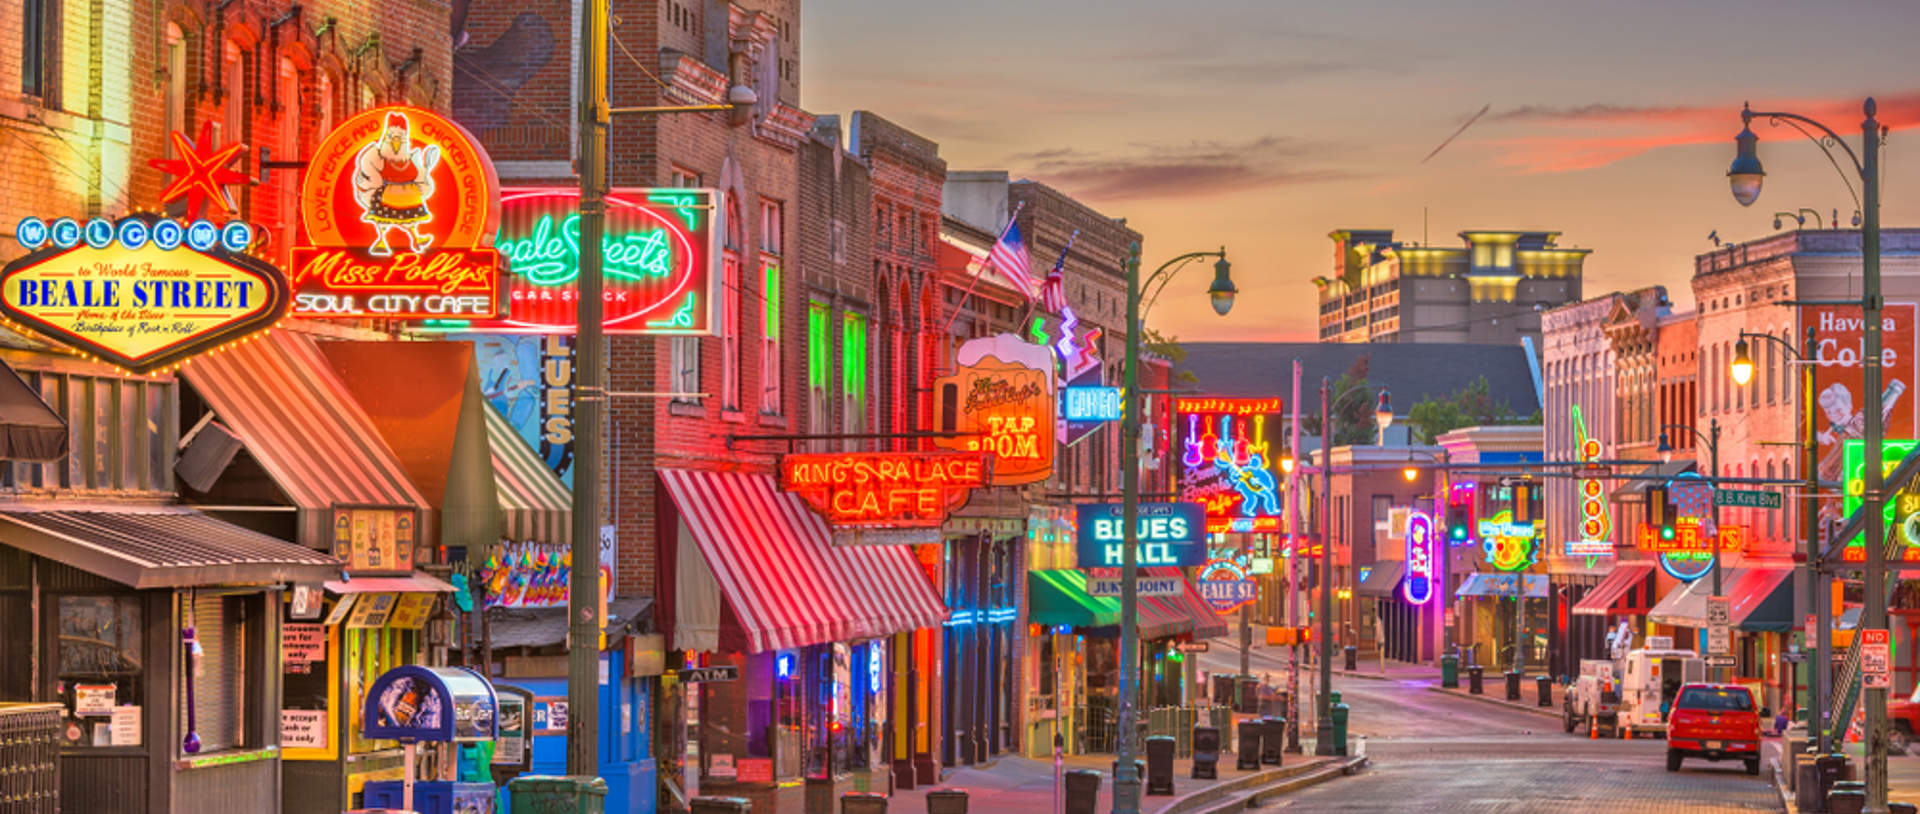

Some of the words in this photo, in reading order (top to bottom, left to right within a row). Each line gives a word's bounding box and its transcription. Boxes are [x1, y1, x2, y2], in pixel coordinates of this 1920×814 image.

[421, 122, 469, 172] CHICKEN
[22, 221, 250, 248] WELCOME
[500, 215, 567, 262] eale
[562, 215, 671, 281] Seets
[94, 262, 137, 277] World
[141, 262, 191, 277] Famous
[296, 251, 382, 283] Miss
[18, 279, 120, 307] BEALE
[132, 280, 253, 308] STREET
[296, 295, 363, 314] SOUL
[368, 295, 420, 313] CITY
[424, 295, 490, 314] CAFE
[512, 289, 553, 301] GAR
[561, 289, 628, 302] SCK
[1819, 311, 1864, 331] Hav
[1882, 317, 1895, 331] a
[546, 334, 571, 445] LUES
[988, 416, 1036, 437] TAP
[793, 458, 868, 482] KING'S
[834, 489, 939, 514] CAFE
[1095, 581, 1120, 593] JUK
[1136, 581, 1175, 593] JOINT
[1202, 583, 1234, 598] EALE
[690, 670, 728, 681] ATM
